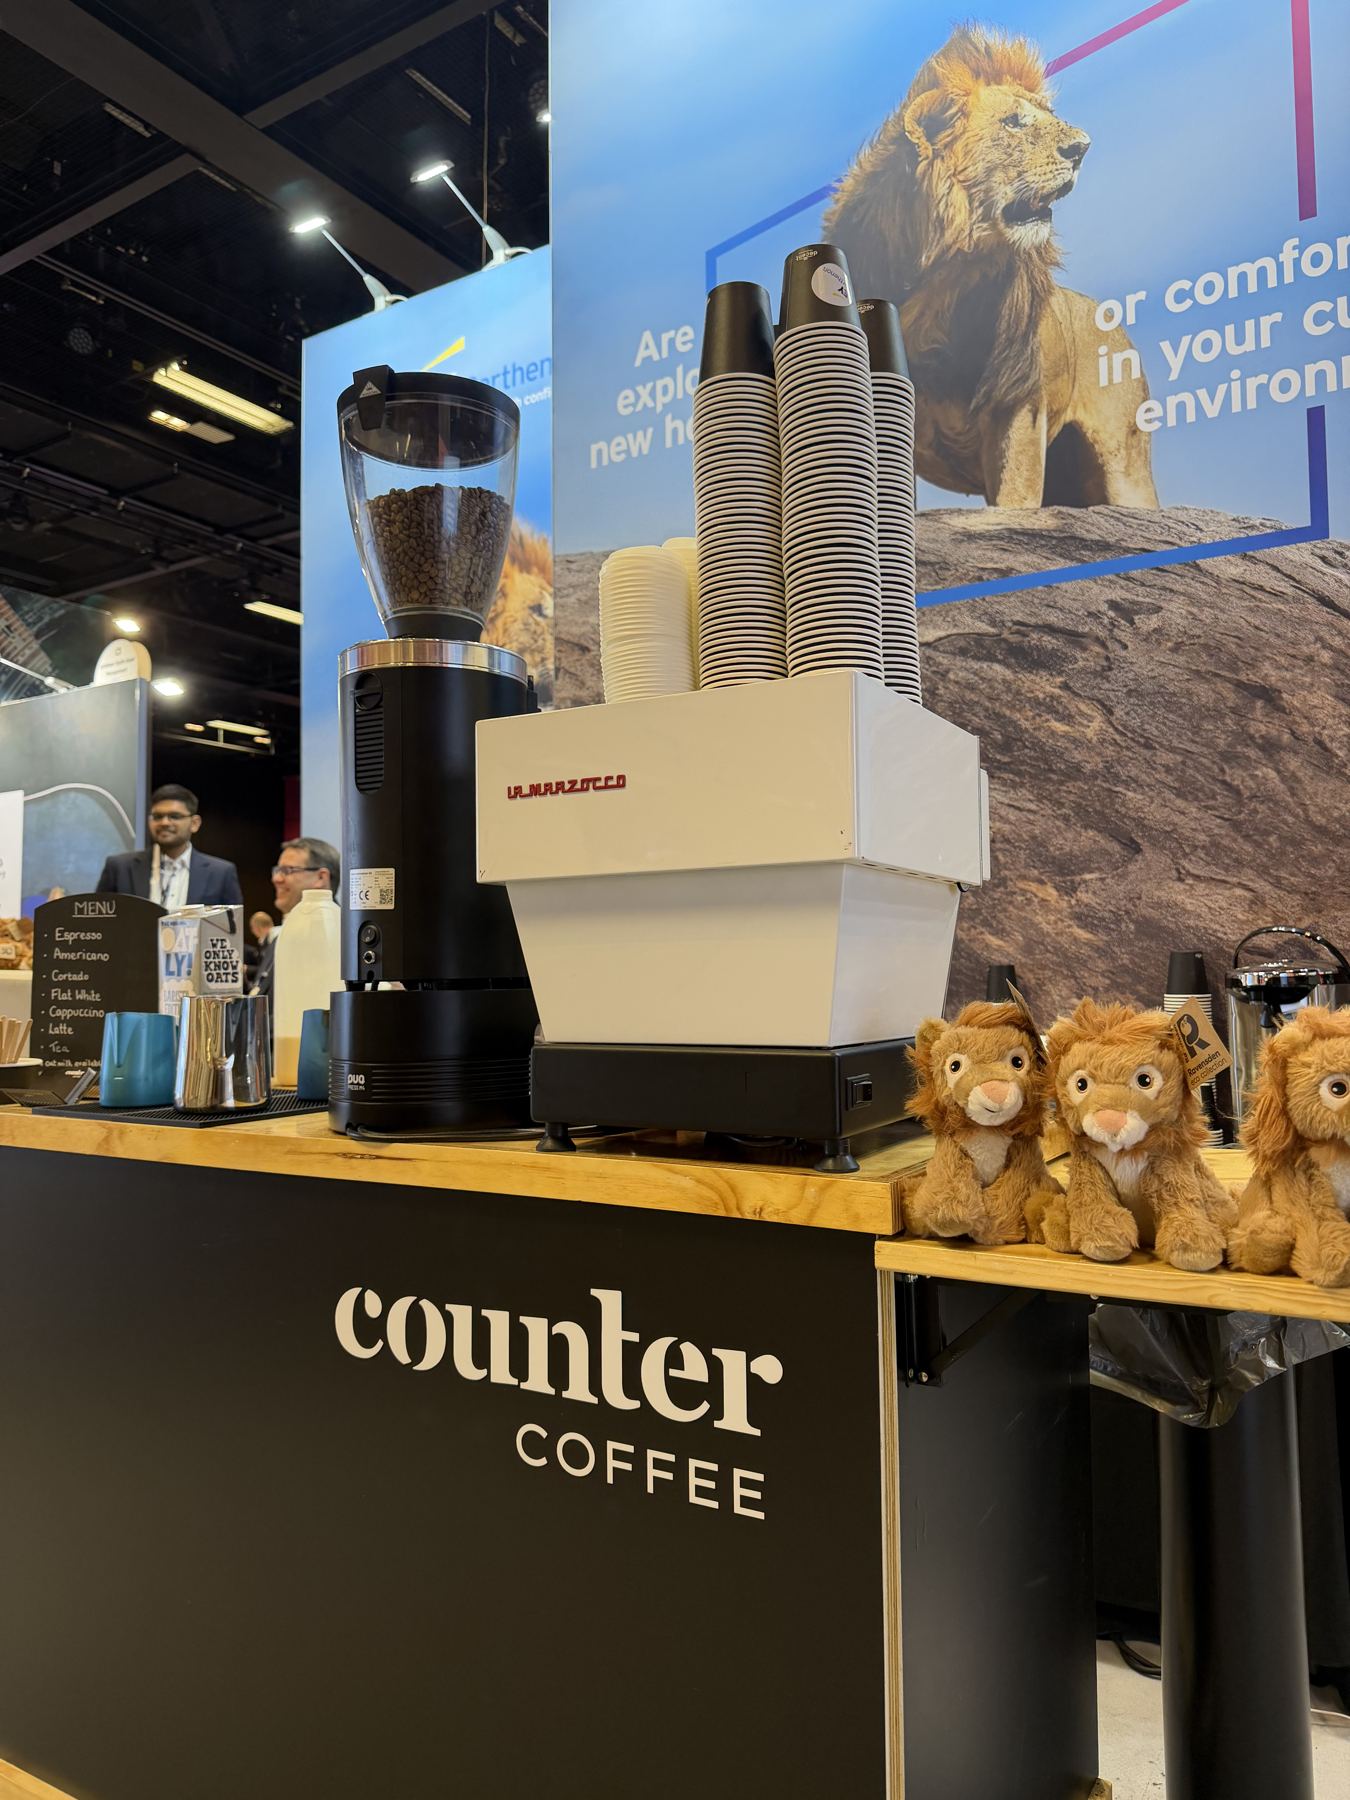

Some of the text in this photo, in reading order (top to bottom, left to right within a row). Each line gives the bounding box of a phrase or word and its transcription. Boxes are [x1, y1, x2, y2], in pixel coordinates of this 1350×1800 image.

[1094, 234, 1350, 331] or comfor
[634, 325, 694, 367] Are
[1097, 345, 1141, 387] in
[1159, 311, 1283, 381] your
[1135, 354, 1350, 432] environ
[590, 427, 653, 469] new
[74, 900, 116, 915] MENU
[55, 927, 102, 945] Espresso
[210, 938, 227, 949] WE
[53, 947, 110, 962] Americano
[204, 949, 234, 960] ONLY
[165, 953, 193, 977] LY!
[204, 960, 239, 972] KNOW
[51, 969, 89, 981] Cortado
[206, 972, 239, 983] OATS
[51, 988, 101, 1002] Flat White
[49, 1005, 105, 1020] Cappuccino
[48, 1023, 74, 1035] Latte
[49, 1041, 70, 1053] Tea
[1187, 1050, 1221, 1077] Ravensden
[1200, 1057, 1228, 1078] collection
[334, 1286, 784, 1437] counter
[515, 1422, 766, 1520] COFFEE
